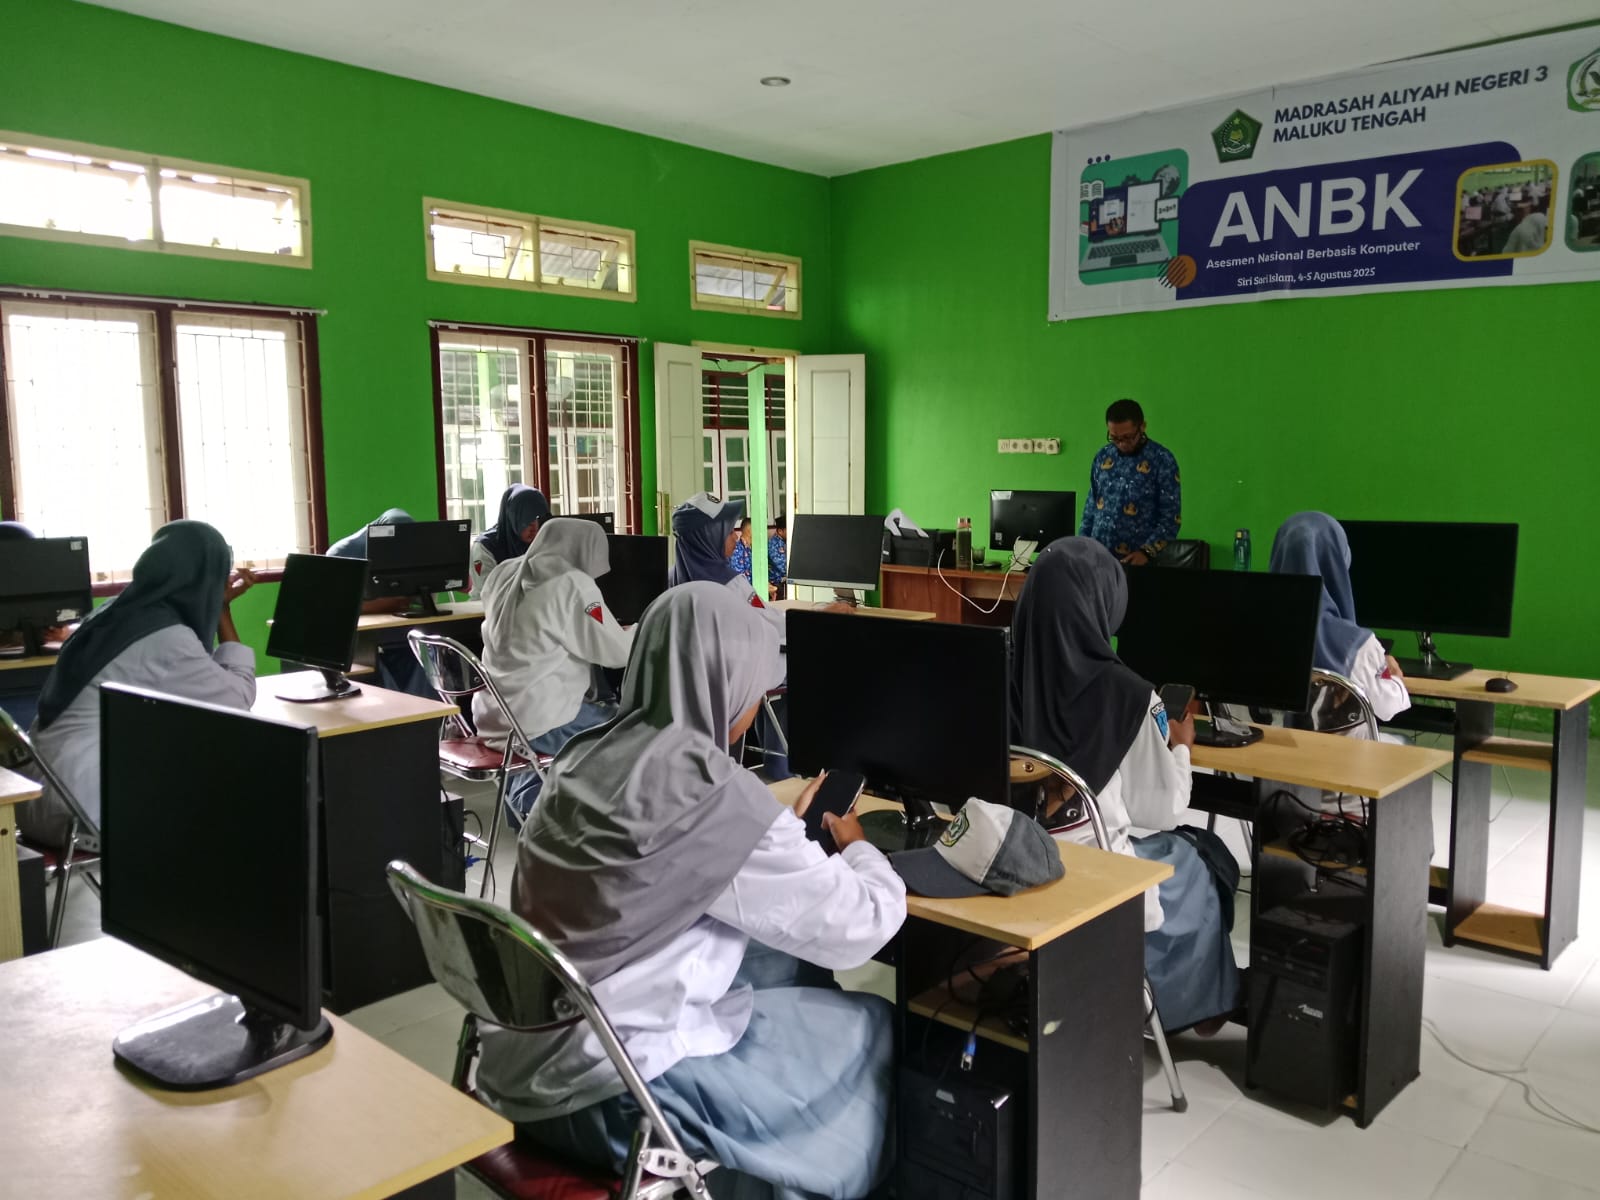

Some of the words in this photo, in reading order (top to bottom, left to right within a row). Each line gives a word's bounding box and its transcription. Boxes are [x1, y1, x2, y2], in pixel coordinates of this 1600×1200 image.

[1274, 94, 1374, 124] MADRASAH
[1378, 82, 1449, 108] ALIYAH
[1454, 68, 1530, 96] NEGERI
[1534, 65, 1548, 82] 3
[1273, 119, 1347, 143] MALUKU
[1351, 106, 1426, 131] TENGAH
[1209, 168, 1424, 248] ANBK
[1206, 256, 1255, 269] Asesmen
[1257, 249, 1304, 263] Nasional
[1306, 245, 1357, 259] Berbasis
[1360, 241, 1421, 255] Komputer
[1237, 276, 1253, 287] Siri
[1313, 270, 1353, 282] Agustus
[1353, 266, 1376, 278] 2025
